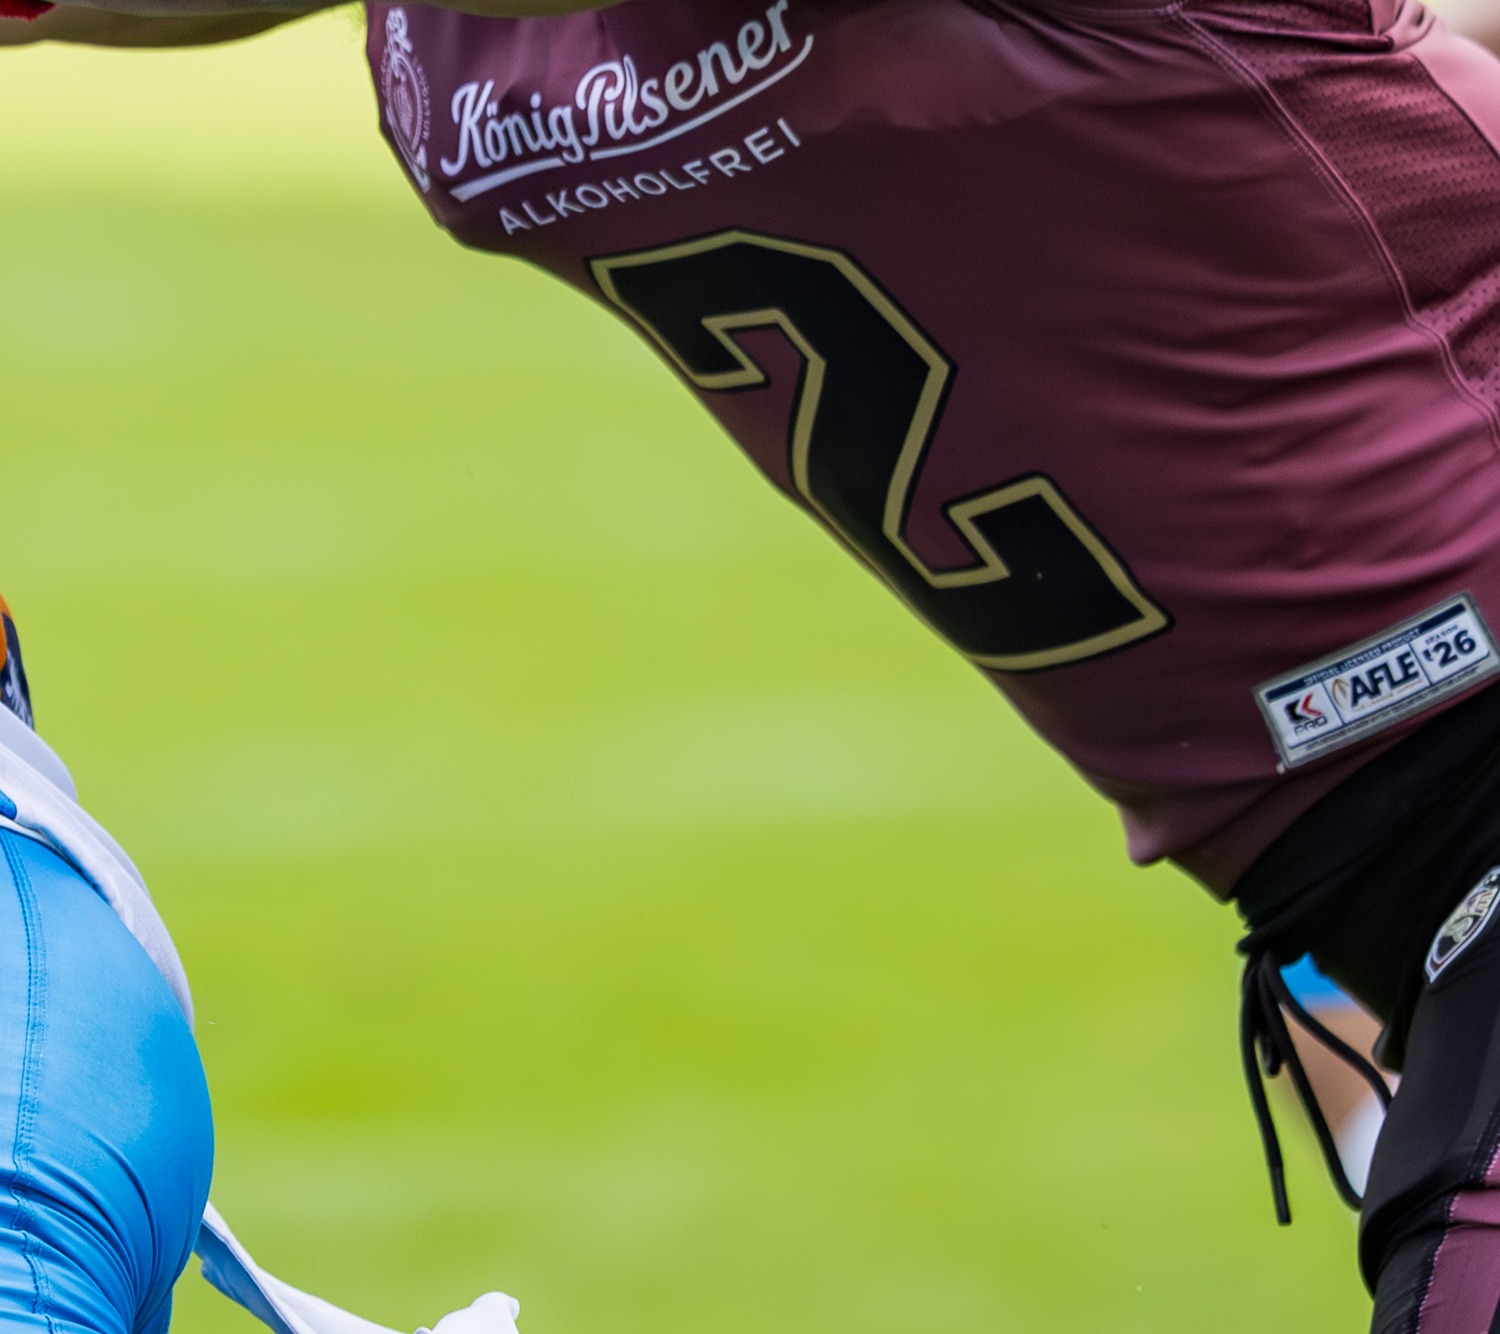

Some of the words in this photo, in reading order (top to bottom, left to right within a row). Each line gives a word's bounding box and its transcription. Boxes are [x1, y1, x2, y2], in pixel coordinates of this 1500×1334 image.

[440, 78, 585, 176] König
[499, 117, 802, 236] ALKOHOLFREI
[586, 229, 1174, 674] 2
[1350, 650, 1421, 709] AFLE
[1421, 629, 1477, 669] '26
[1293, 715, 1329, 737] PRO
